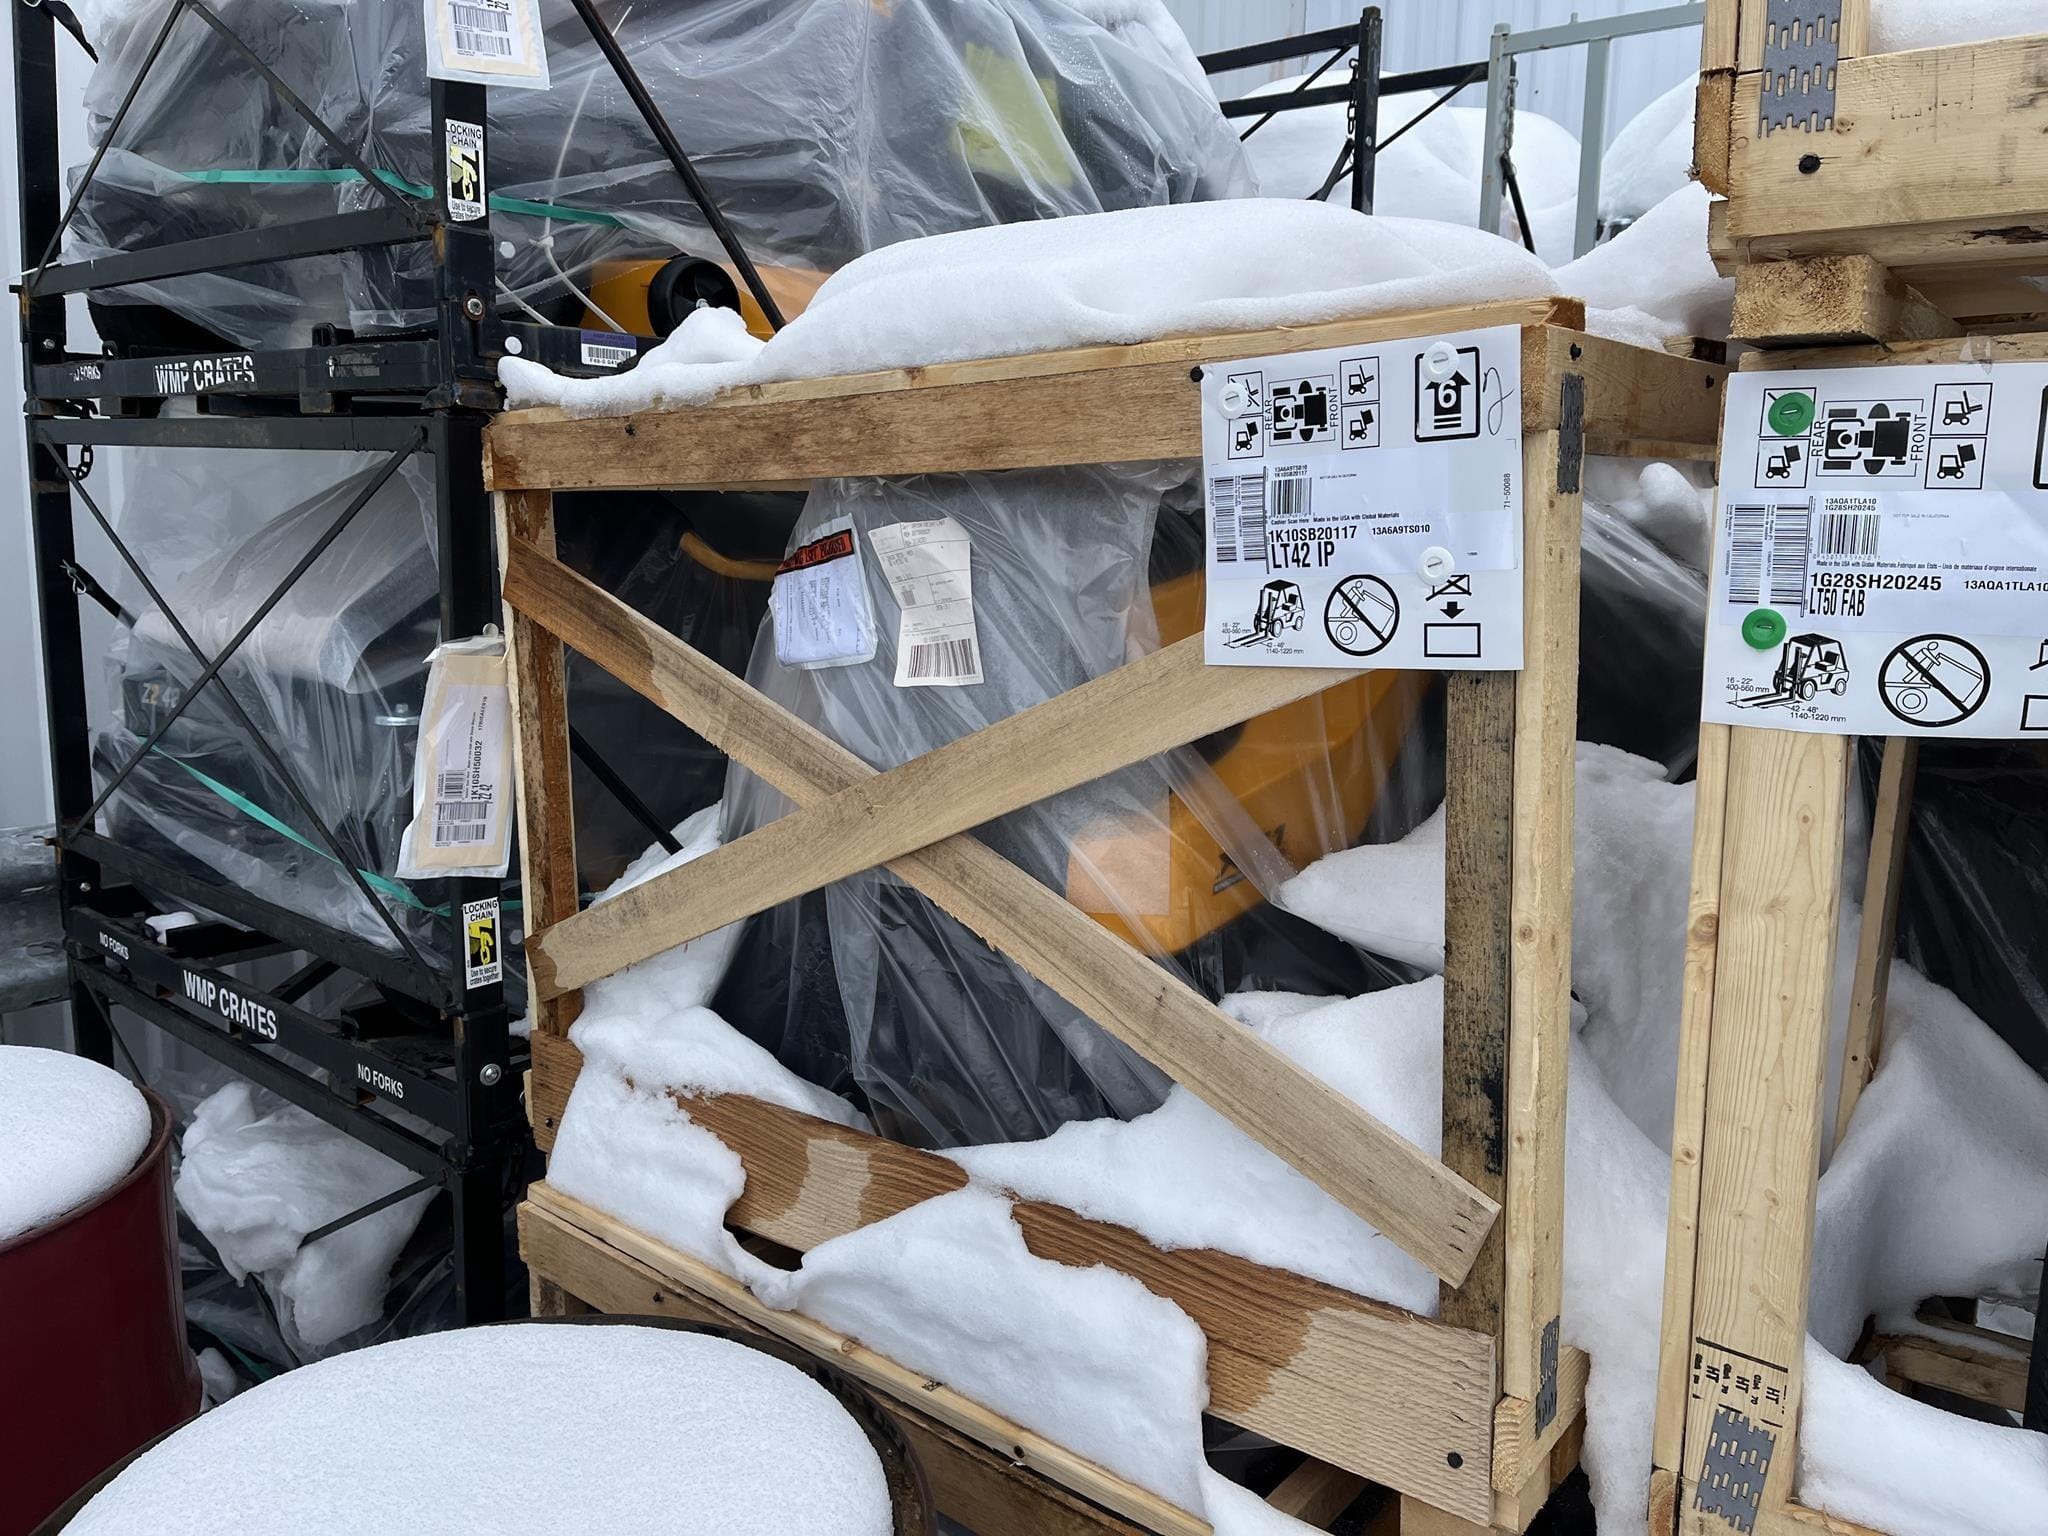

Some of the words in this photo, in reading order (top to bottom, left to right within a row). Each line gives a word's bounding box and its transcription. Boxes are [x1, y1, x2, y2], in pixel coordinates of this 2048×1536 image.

[452, 135, 477, 149] CHAIN
[155, 362, 189, 393] WMP
[193, 355, 255, 391] CRATES
[1329, 388, 1339, 427] FRONT
[1438, 380, 1457, 408] 6
[1265, 399, 1273, 430] REAR
[1811, 421, 1826, 457] REAR
[1911, 414, 1927, 461] FRONT
[1268, 525, 1357, 543] 1K10SB20117
[1372, 524, 1430, 536] 13A6A9TS010
[1271, 542, 1311, 568] LT42
[1318, 541, 1335, 567] IP
[1810, 572, 1942, 591] 1G28SH20245
[1809, 587, 1837, 615] LT50
[1841, 588, 1866, 616] FAB
[1726, 676, 1735, 684] 16
[1726, 684, 1754, 692] 400-560
[1790, 712, 1829, 721] 1140-1220
[471, 740, 483, 800] 1K10SH50032
[464, 900, 498, 914] LOCKING
[470, 910, 493, 921] CHAIN
[99, 932, 109, 947] NO
[109, 937, 129, 960] FORKS
[183, 970, 216, 1008] WMP
[219, 988, 277, 1040] CRATES
[358, 1063, 370, 1083] NO
[372, 1070, 404, 1099] FORKS
[1706, 1365, 1720, 1384] HT
[1735, 1375, 1750, 1394] HT
[1766, 1386, 1780, 1405] HT
